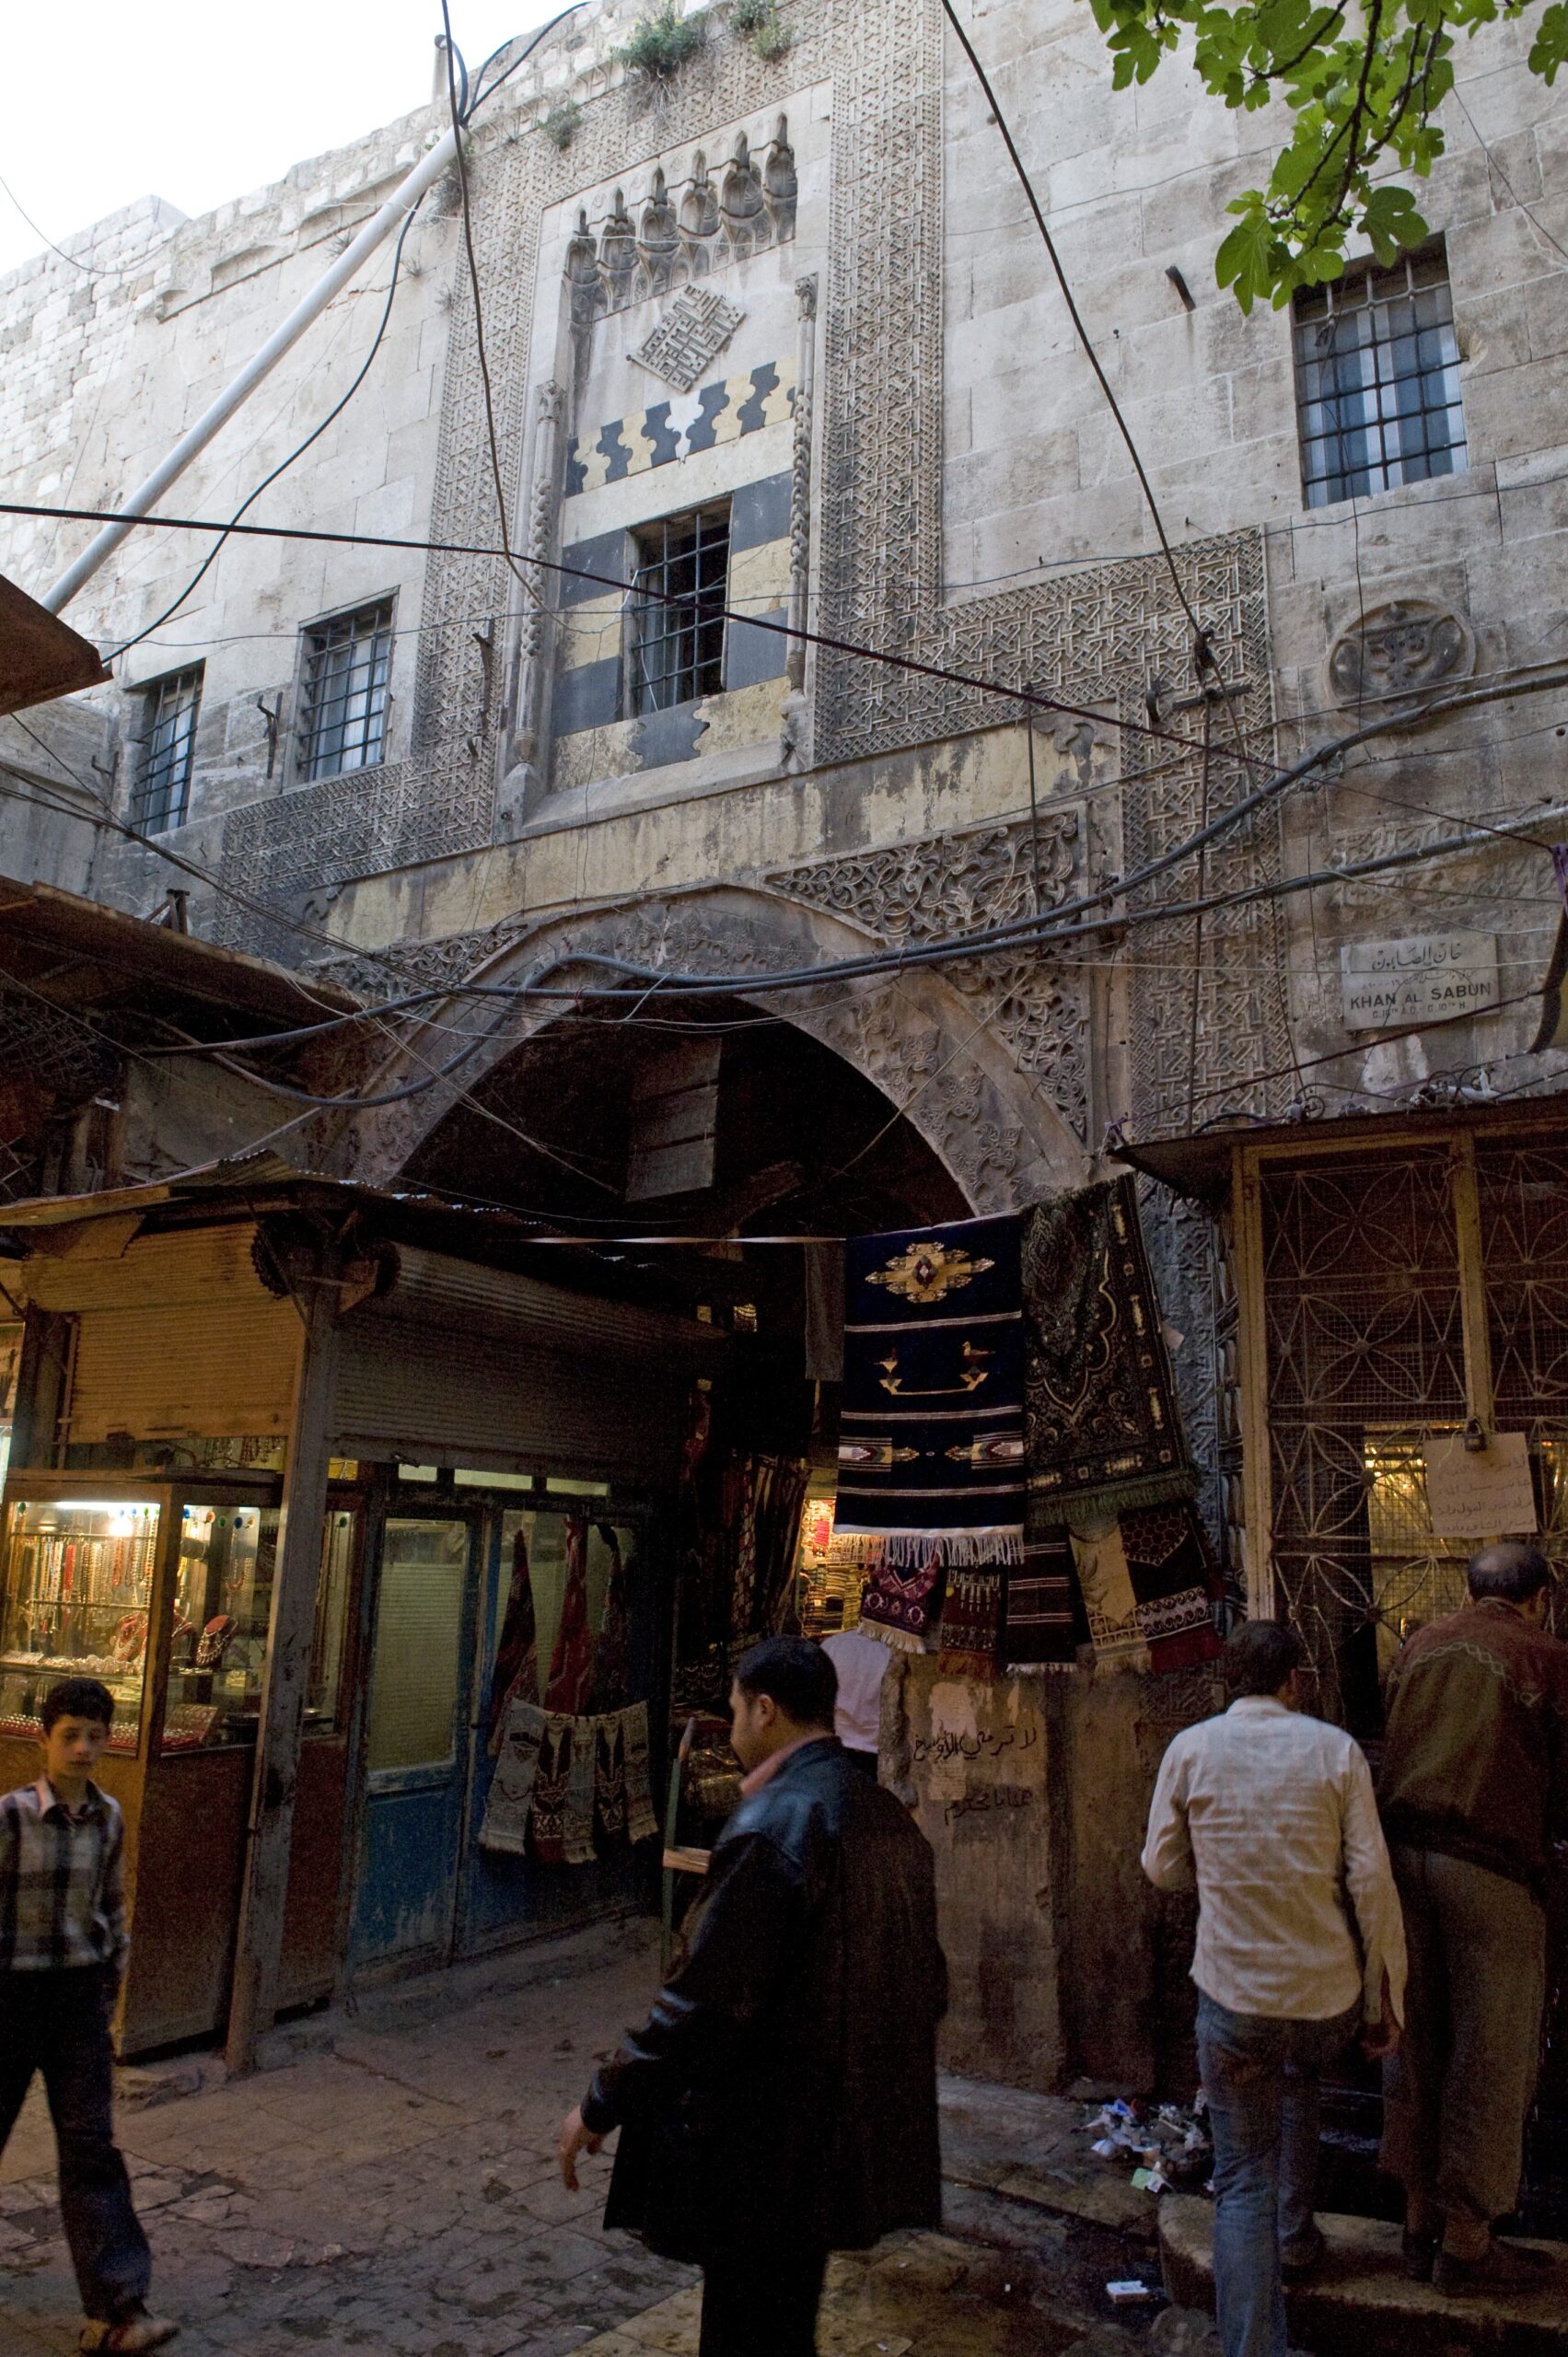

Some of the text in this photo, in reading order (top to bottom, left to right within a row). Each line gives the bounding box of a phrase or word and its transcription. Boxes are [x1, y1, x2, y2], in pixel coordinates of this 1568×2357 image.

[1434, 943, 1461, 963] خان
[1351, 982, 1491, 1009] KHAN AL SABUN
[959, 1725, 1016, 1759] ترمي
[1019, 1726, 1037, 1749] لا
